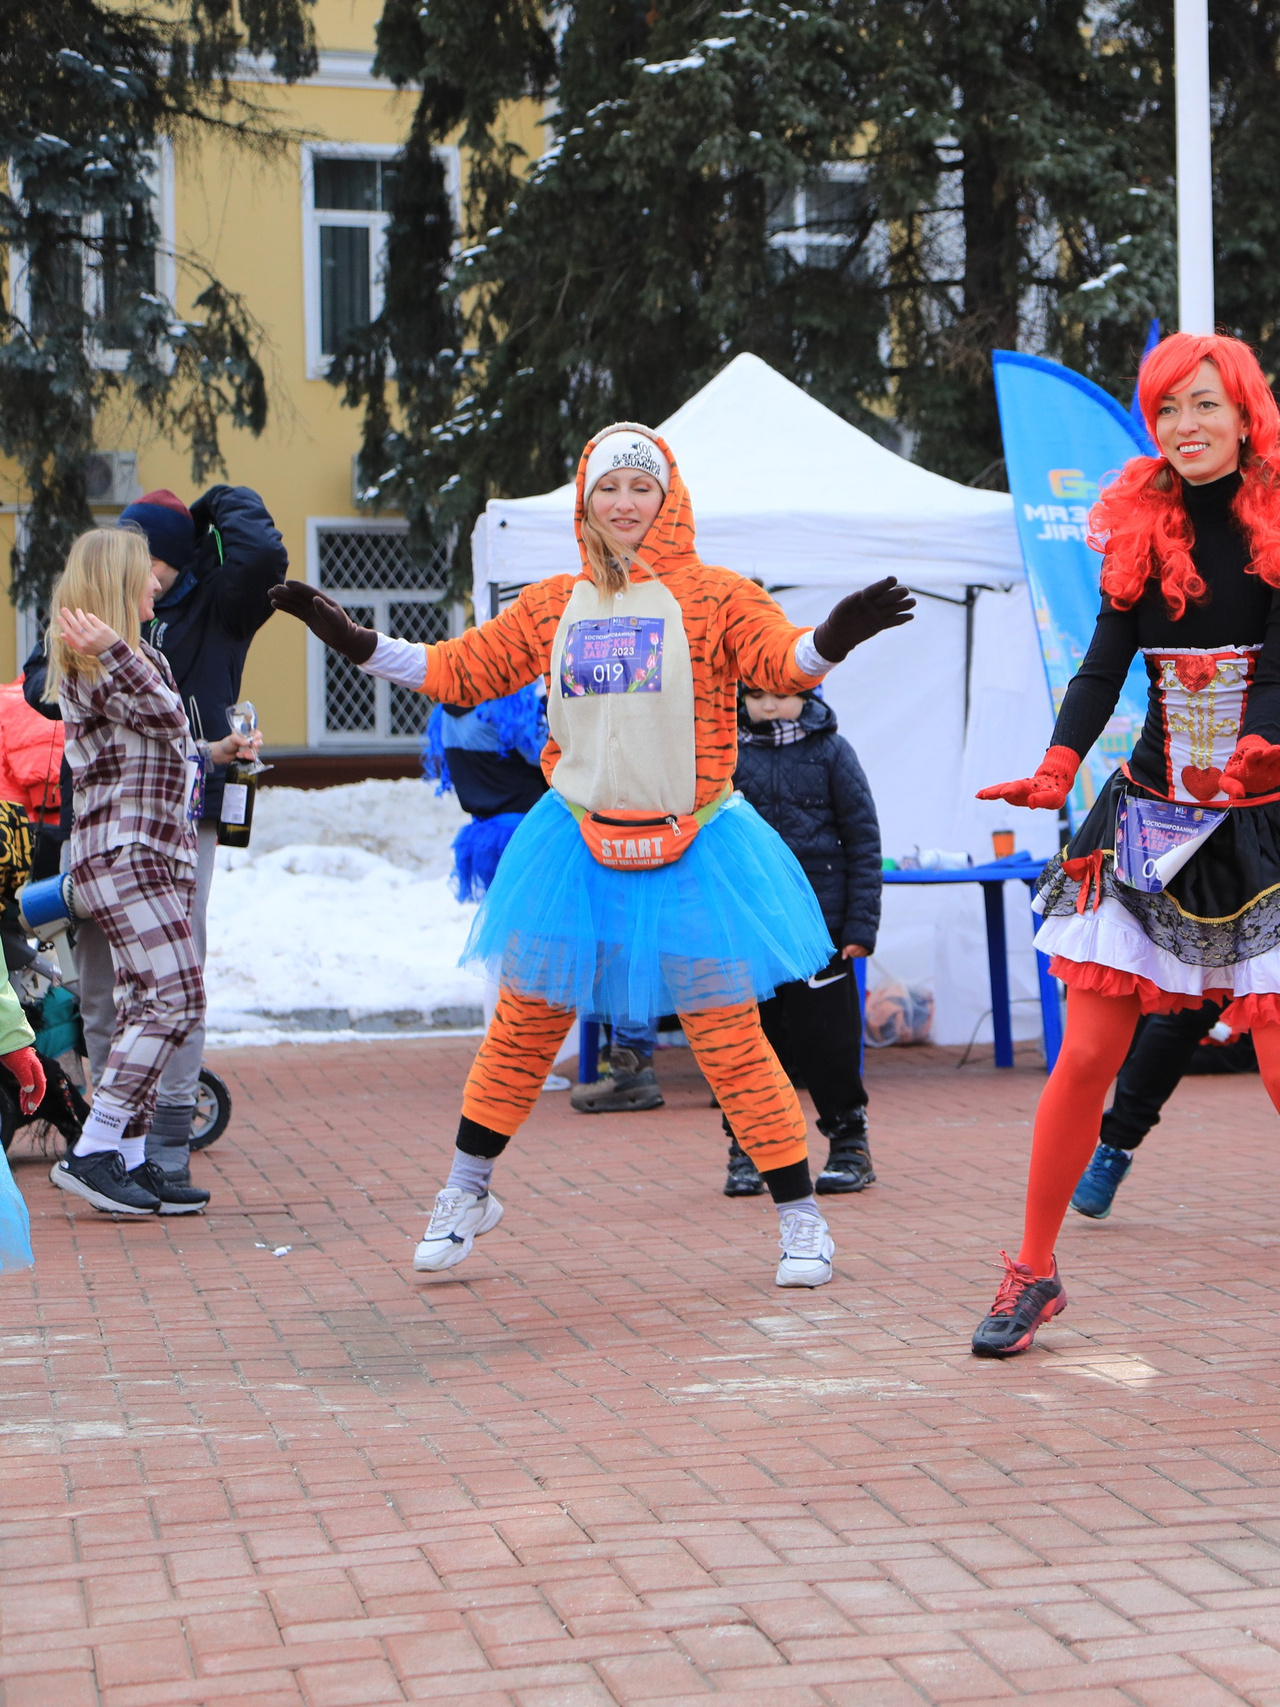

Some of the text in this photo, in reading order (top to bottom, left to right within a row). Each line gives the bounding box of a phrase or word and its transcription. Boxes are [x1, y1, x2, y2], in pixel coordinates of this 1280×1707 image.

[622, 452, 661, 471] SECONDS
[624, 459, 660, 476] SUMMER
[584, 630, 636, 640] КОСТЮМИРОВАННЫЙ
[584, 637, 636, 650] ЖЕНСКИЙ
[612, 646, 635, 657] 2023
[593, 663, 624, 684] 019
[1142, 819, 1199, 835] КОСТЮМИРОВАННЫЙ
[600, 836, 663, 858] START
[1136, 836, 1169, 852] ЗАБЕГ
